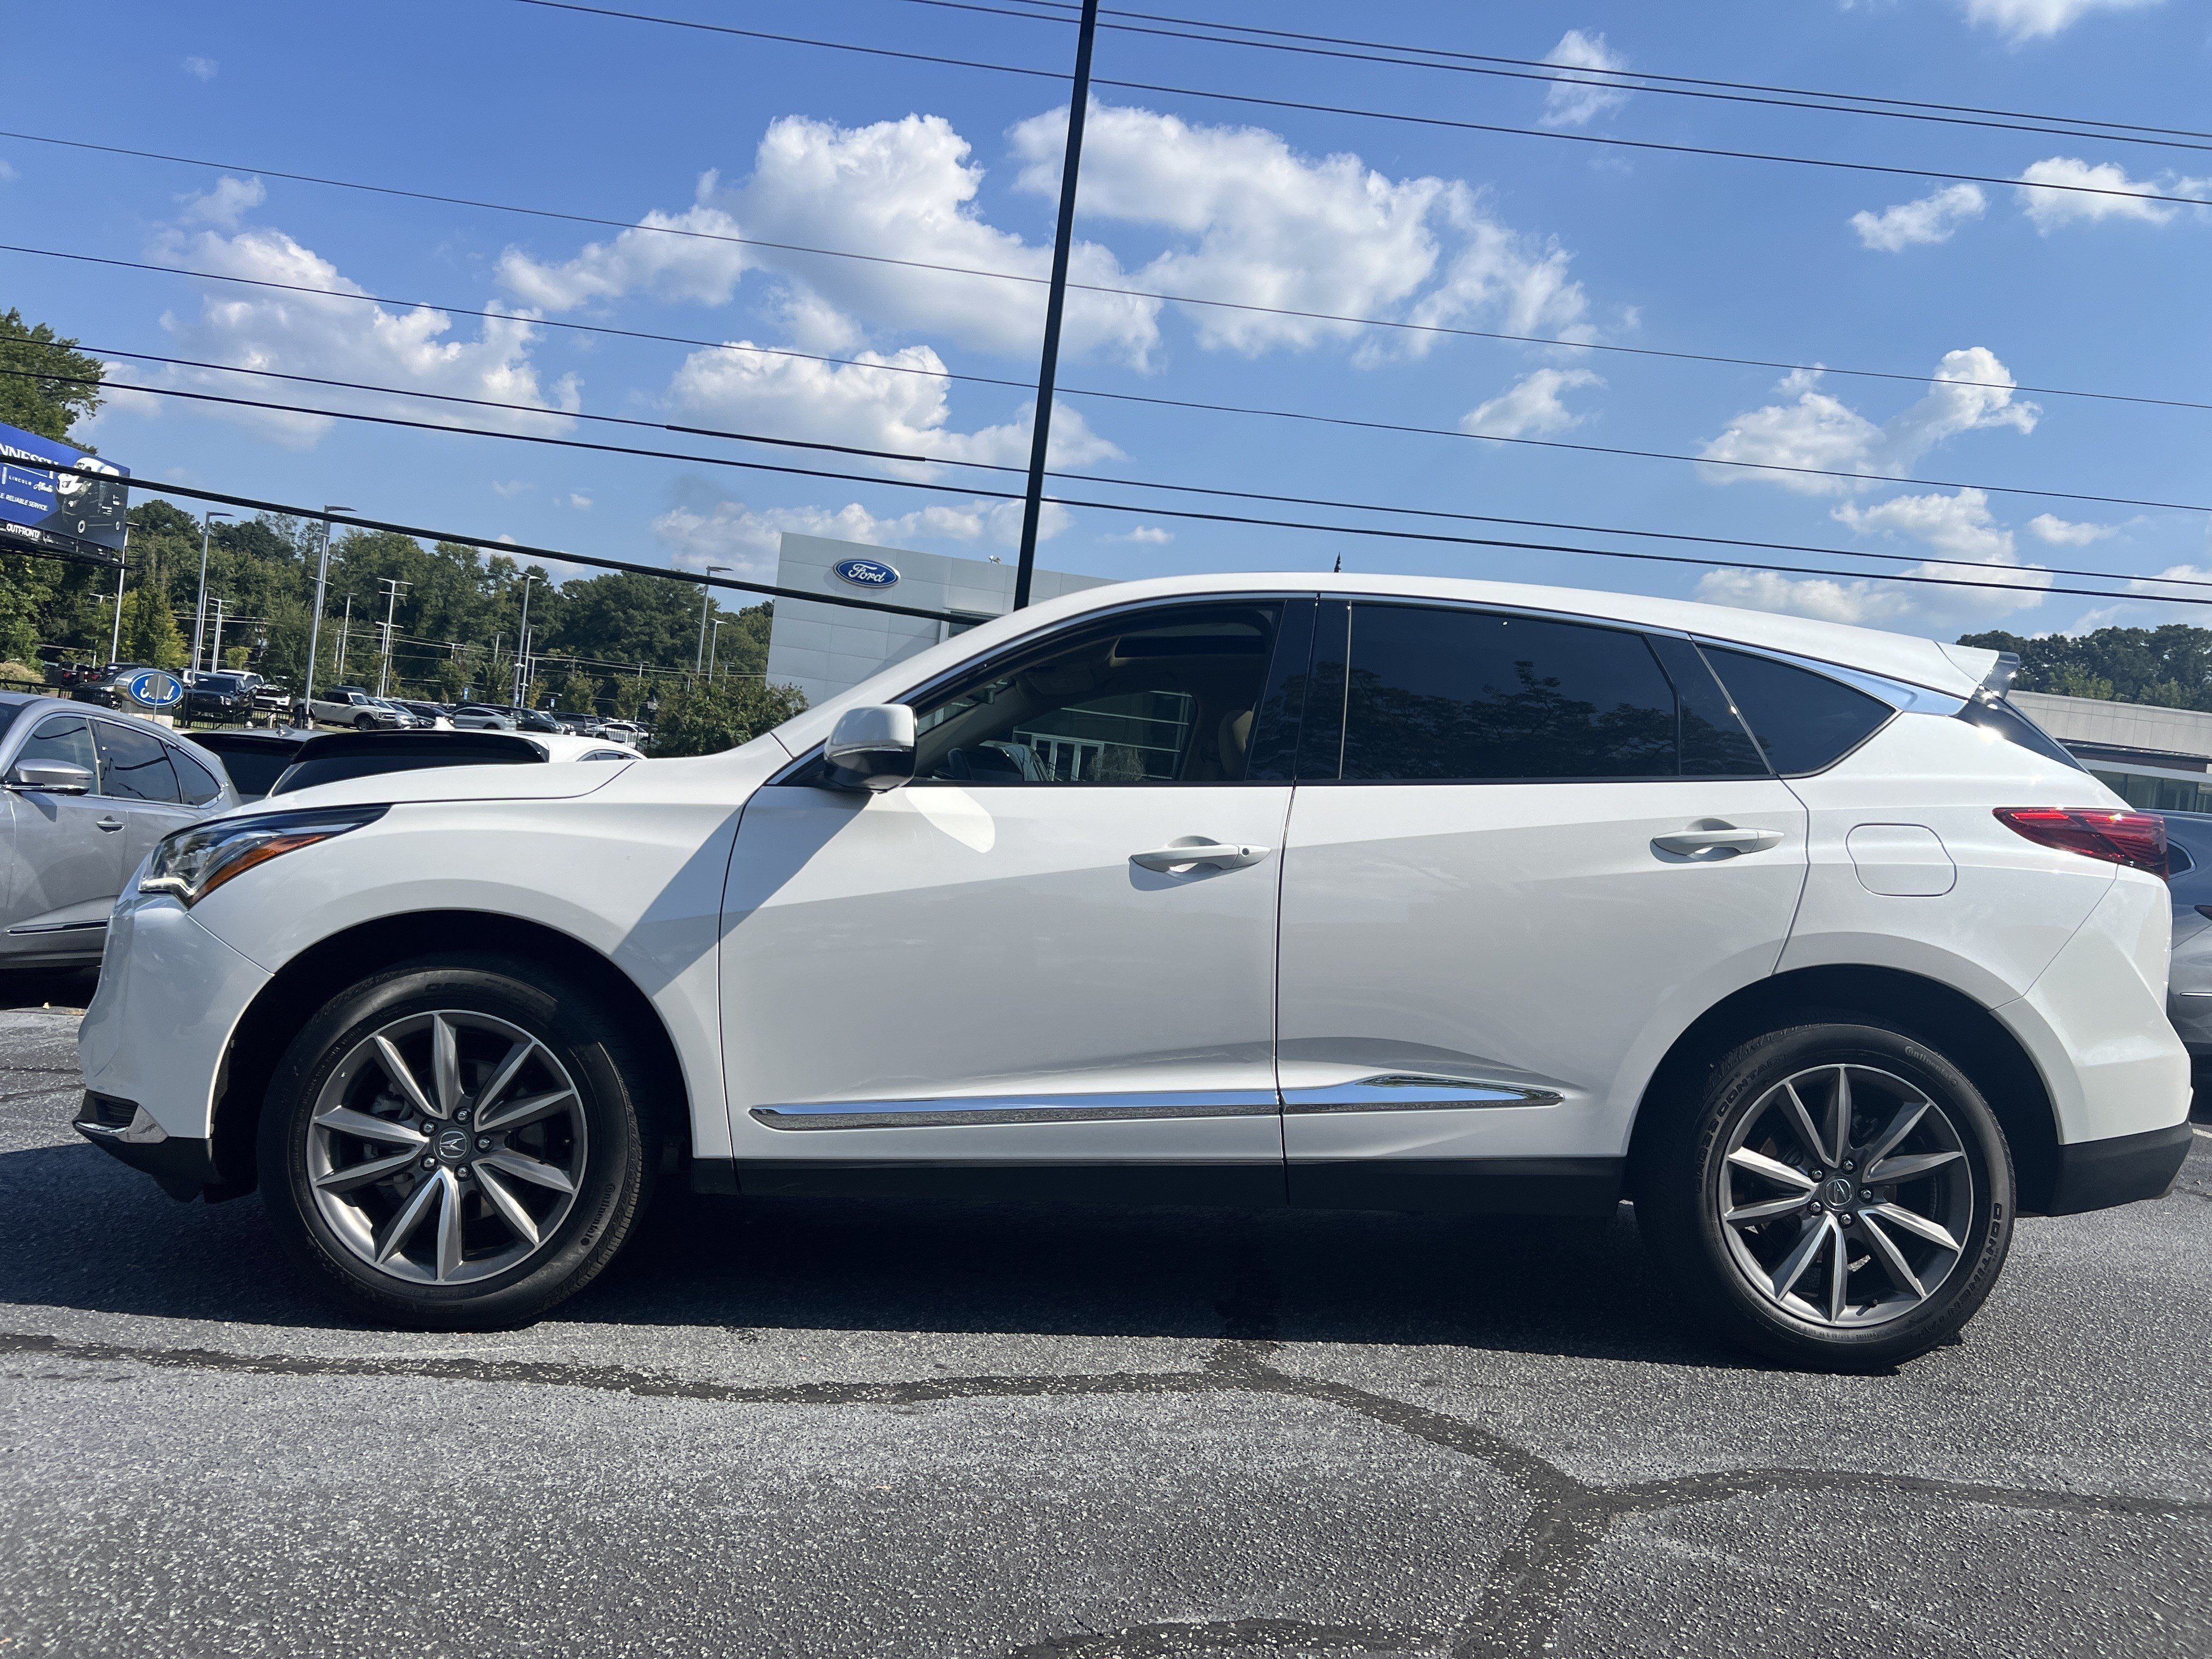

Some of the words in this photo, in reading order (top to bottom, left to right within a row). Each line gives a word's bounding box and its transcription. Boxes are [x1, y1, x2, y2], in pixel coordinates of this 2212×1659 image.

[9, 475, 32, 486] LINCOLN
[5, 494, 29, 506] RELIABLE
[28, 501, 48, 511] SERVICE
[848, 563, 887, 583] Ford
[584, 1184, 615, 1238] Continental
[1912, 1203, 2002, 1338] CONTINENTAL
